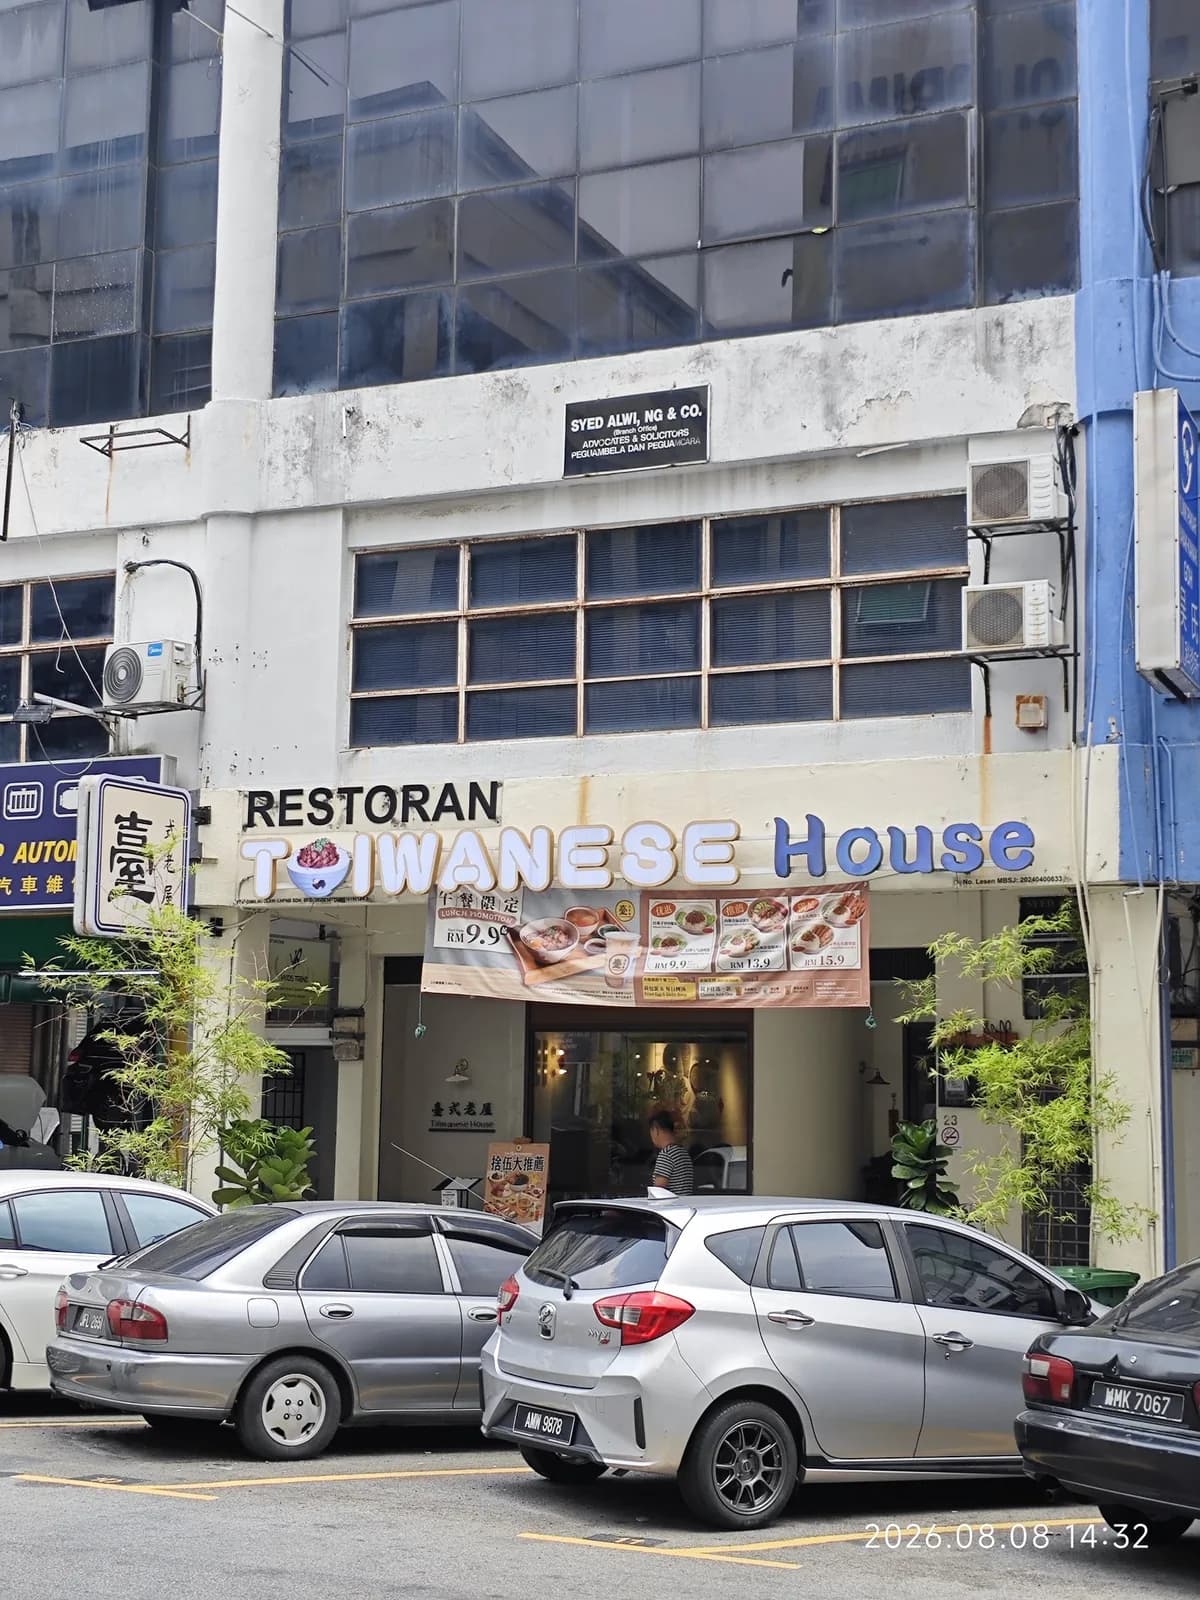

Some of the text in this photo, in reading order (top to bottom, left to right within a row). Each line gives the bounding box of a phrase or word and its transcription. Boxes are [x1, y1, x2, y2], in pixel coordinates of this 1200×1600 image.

[571, 404, 702, 432] SYED ALWI, NG & CO.
[582, 436, 630, 449] ADVOCATES
[640, 428, 690, 442] SOLICITORS
[613, 424, 658, 437] (Branch Office)
[571, 438, 701, 459] PEGUAMBELA DAN PEGUAMCARA
[246, 780, 499, 829] RESTORAN
[240, 814, 1035, 898] TIWANESE House
[0, 874, 77, 896] 汽車維
[441, 909, 468, 917] LUNCH
[447, 932, 464, 943] RM
[669, 959, 687, 969] 9.9
[730, 957, 771, 970] RM 13.9
[820, 954, 845, 966] 15.9
[431, 1101, 493, 1117] 臺式老屋
[943, 1115, 958, 1126] 23
[1104, 1387, 1171, 1415] WMK 7067
[542, 1415, 563, 1435] 9878
